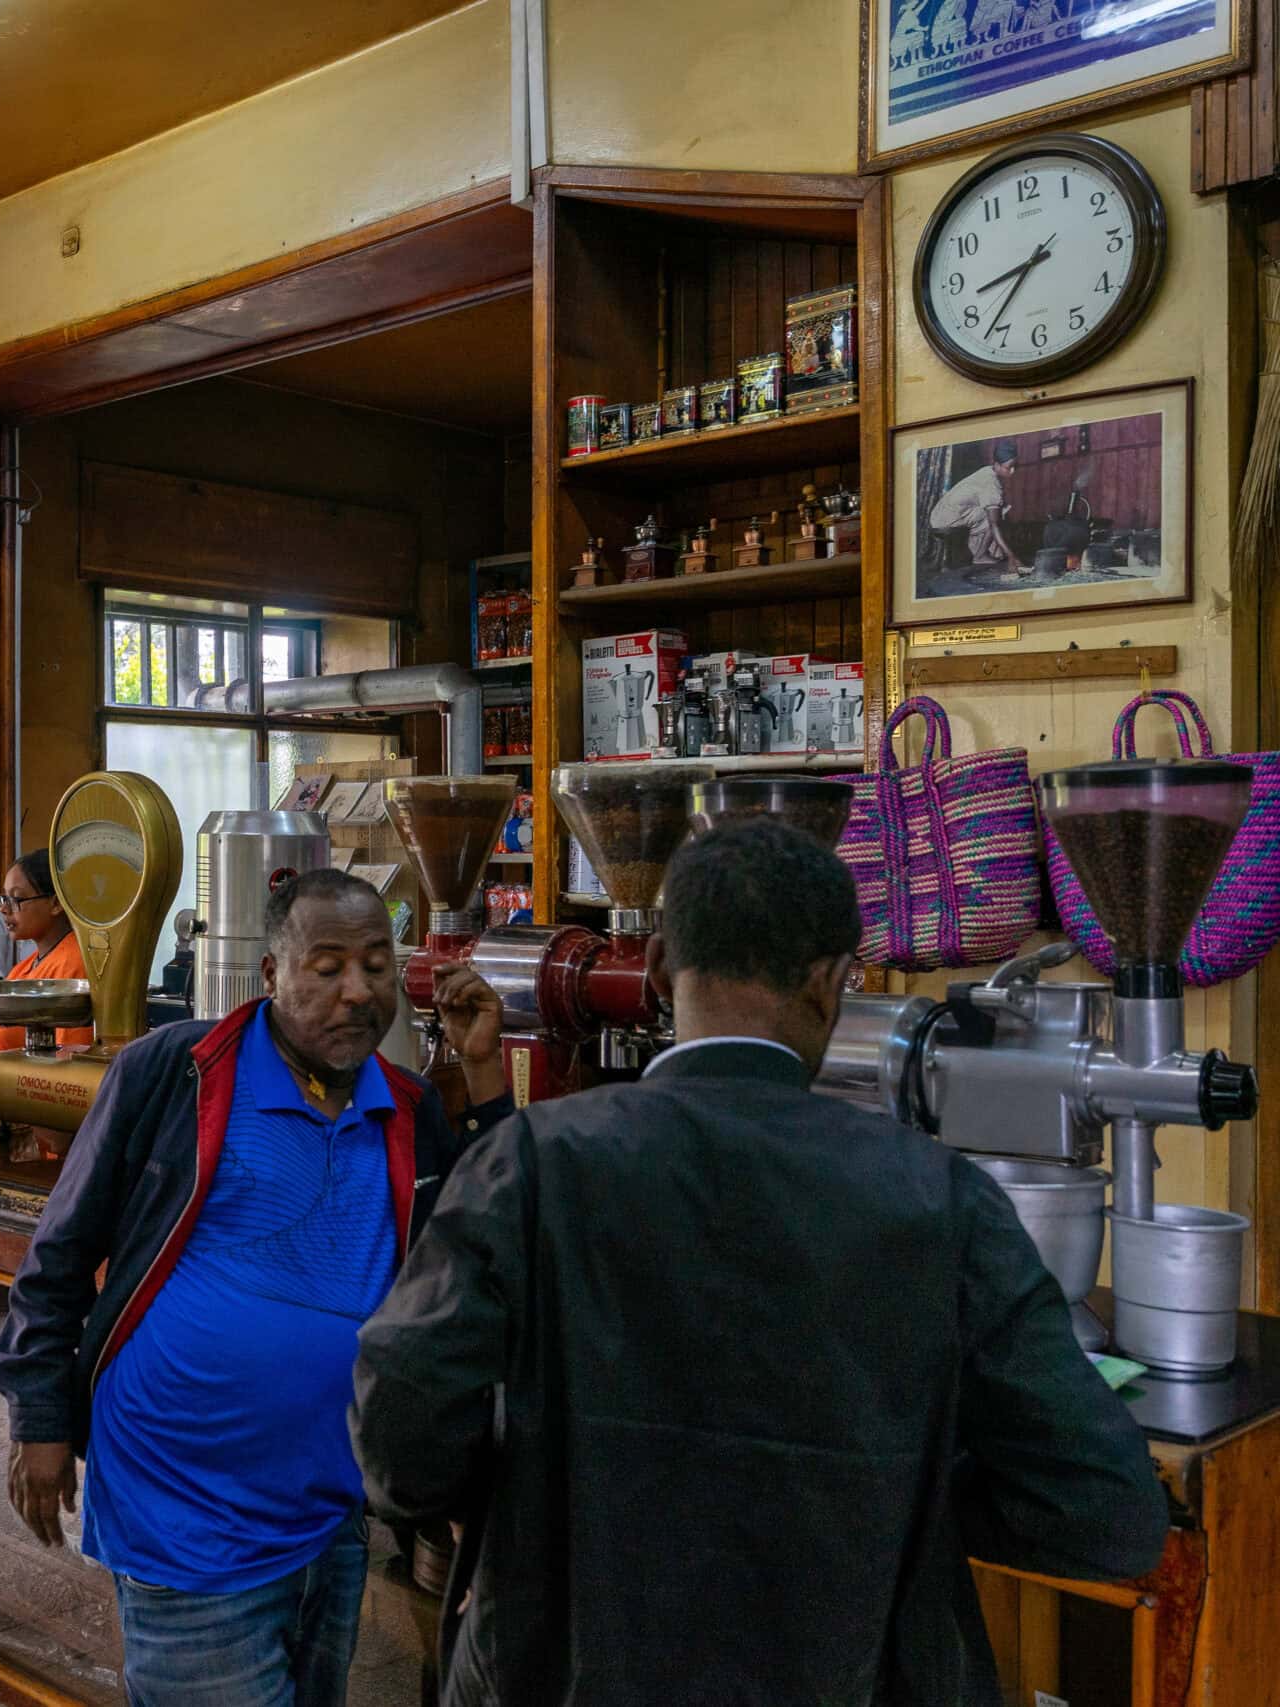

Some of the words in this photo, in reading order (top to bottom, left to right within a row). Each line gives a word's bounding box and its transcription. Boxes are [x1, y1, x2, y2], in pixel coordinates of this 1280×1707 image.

[917, 49, 984, 78] ETHIOPIAN
[992, 31, 1044, 57] COFFEE
[1017, 175, 1040, 202] 12
[1061, 175, 1069, 198] 1
[984, 197, 1000, 222] 11
[1090, 192, 1108, 217] 2
[957, 232, 979, 258] 10
[1106, 227, 1124, 253] 3
[949, 272, 965, 295] 9
[1094, 270, 1113, 294] 4
[964, 305, 980, 328] 8
[1069, 305, 1085, 330] 5
[995, 323, 1012, 348] 7
[1031, 323, 1048, 348] 6
[16, 1075, 51, 1090] TOMOCA
[55, 1081, 88, 1096] COFFEE
